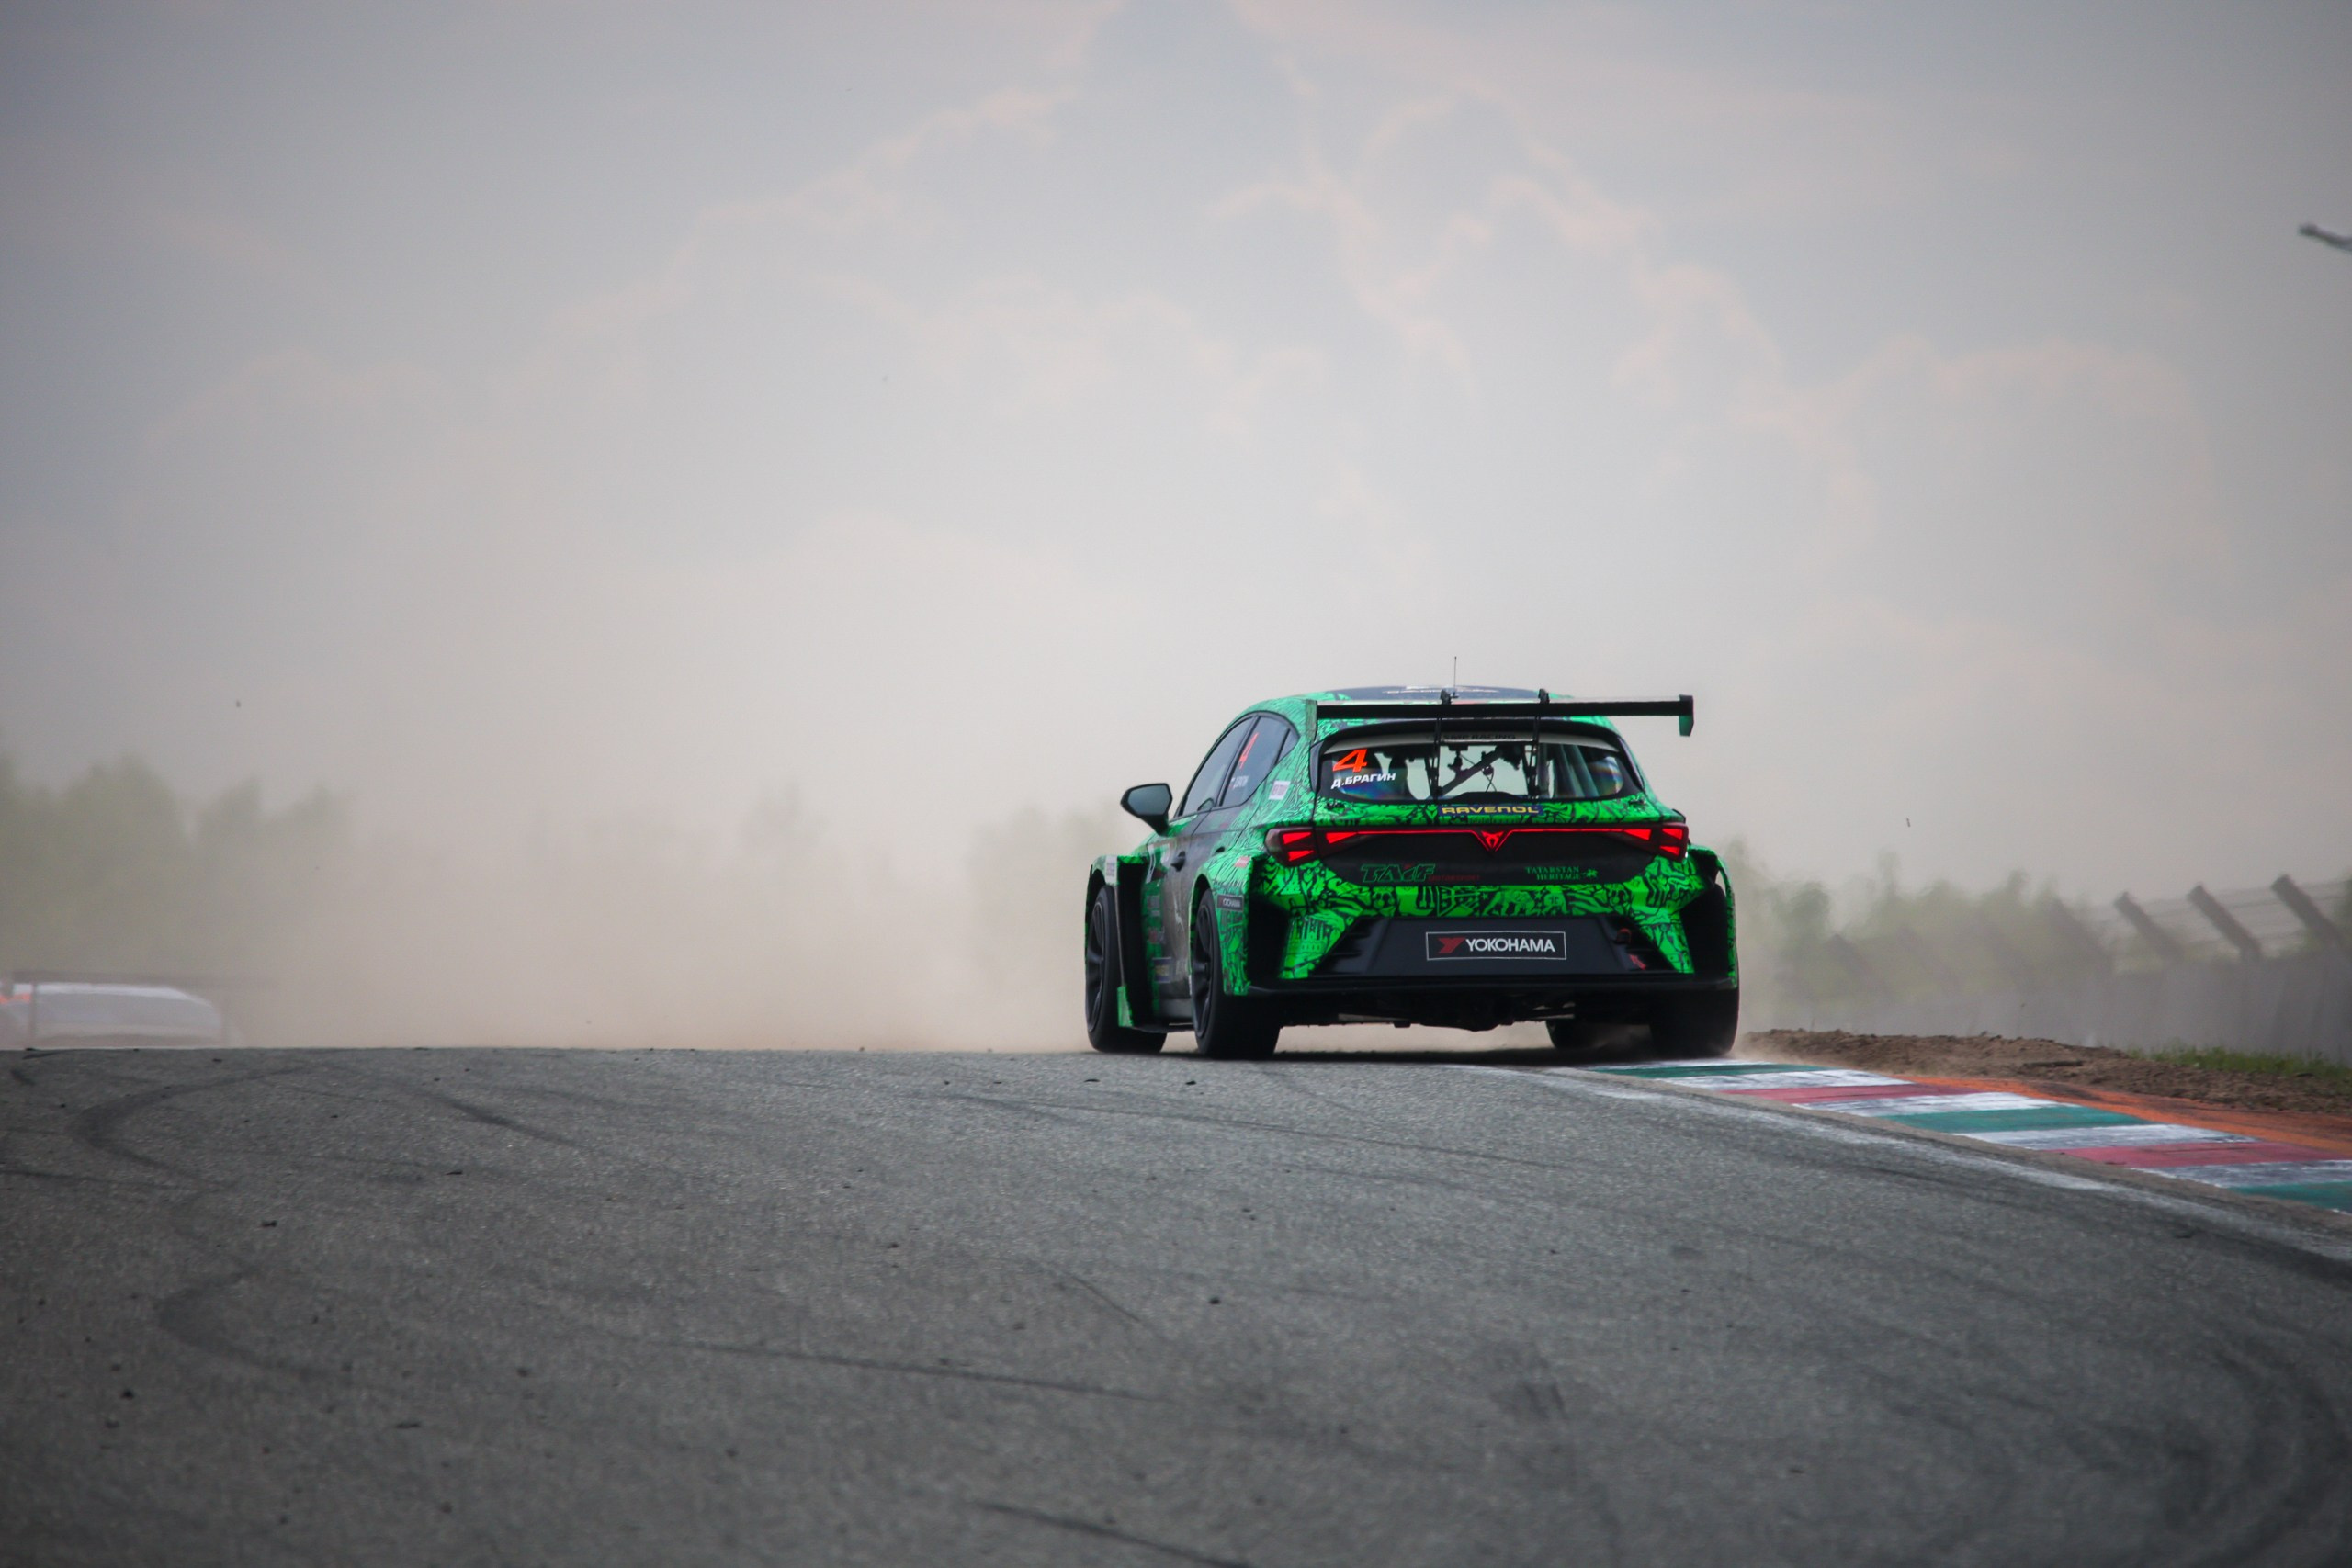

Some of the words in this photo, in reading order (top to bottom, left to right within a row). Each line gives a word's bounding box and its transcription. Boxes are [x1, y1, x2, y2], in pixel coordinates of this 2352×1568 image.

[1332, 748, 1368, 773] 4
[1330, 773, 1396, 790] Д.БРАГИН
[1442, 806, 1540, 815] RAVENOL
[1465, 938, 1556, 953] YOKOHAMA
